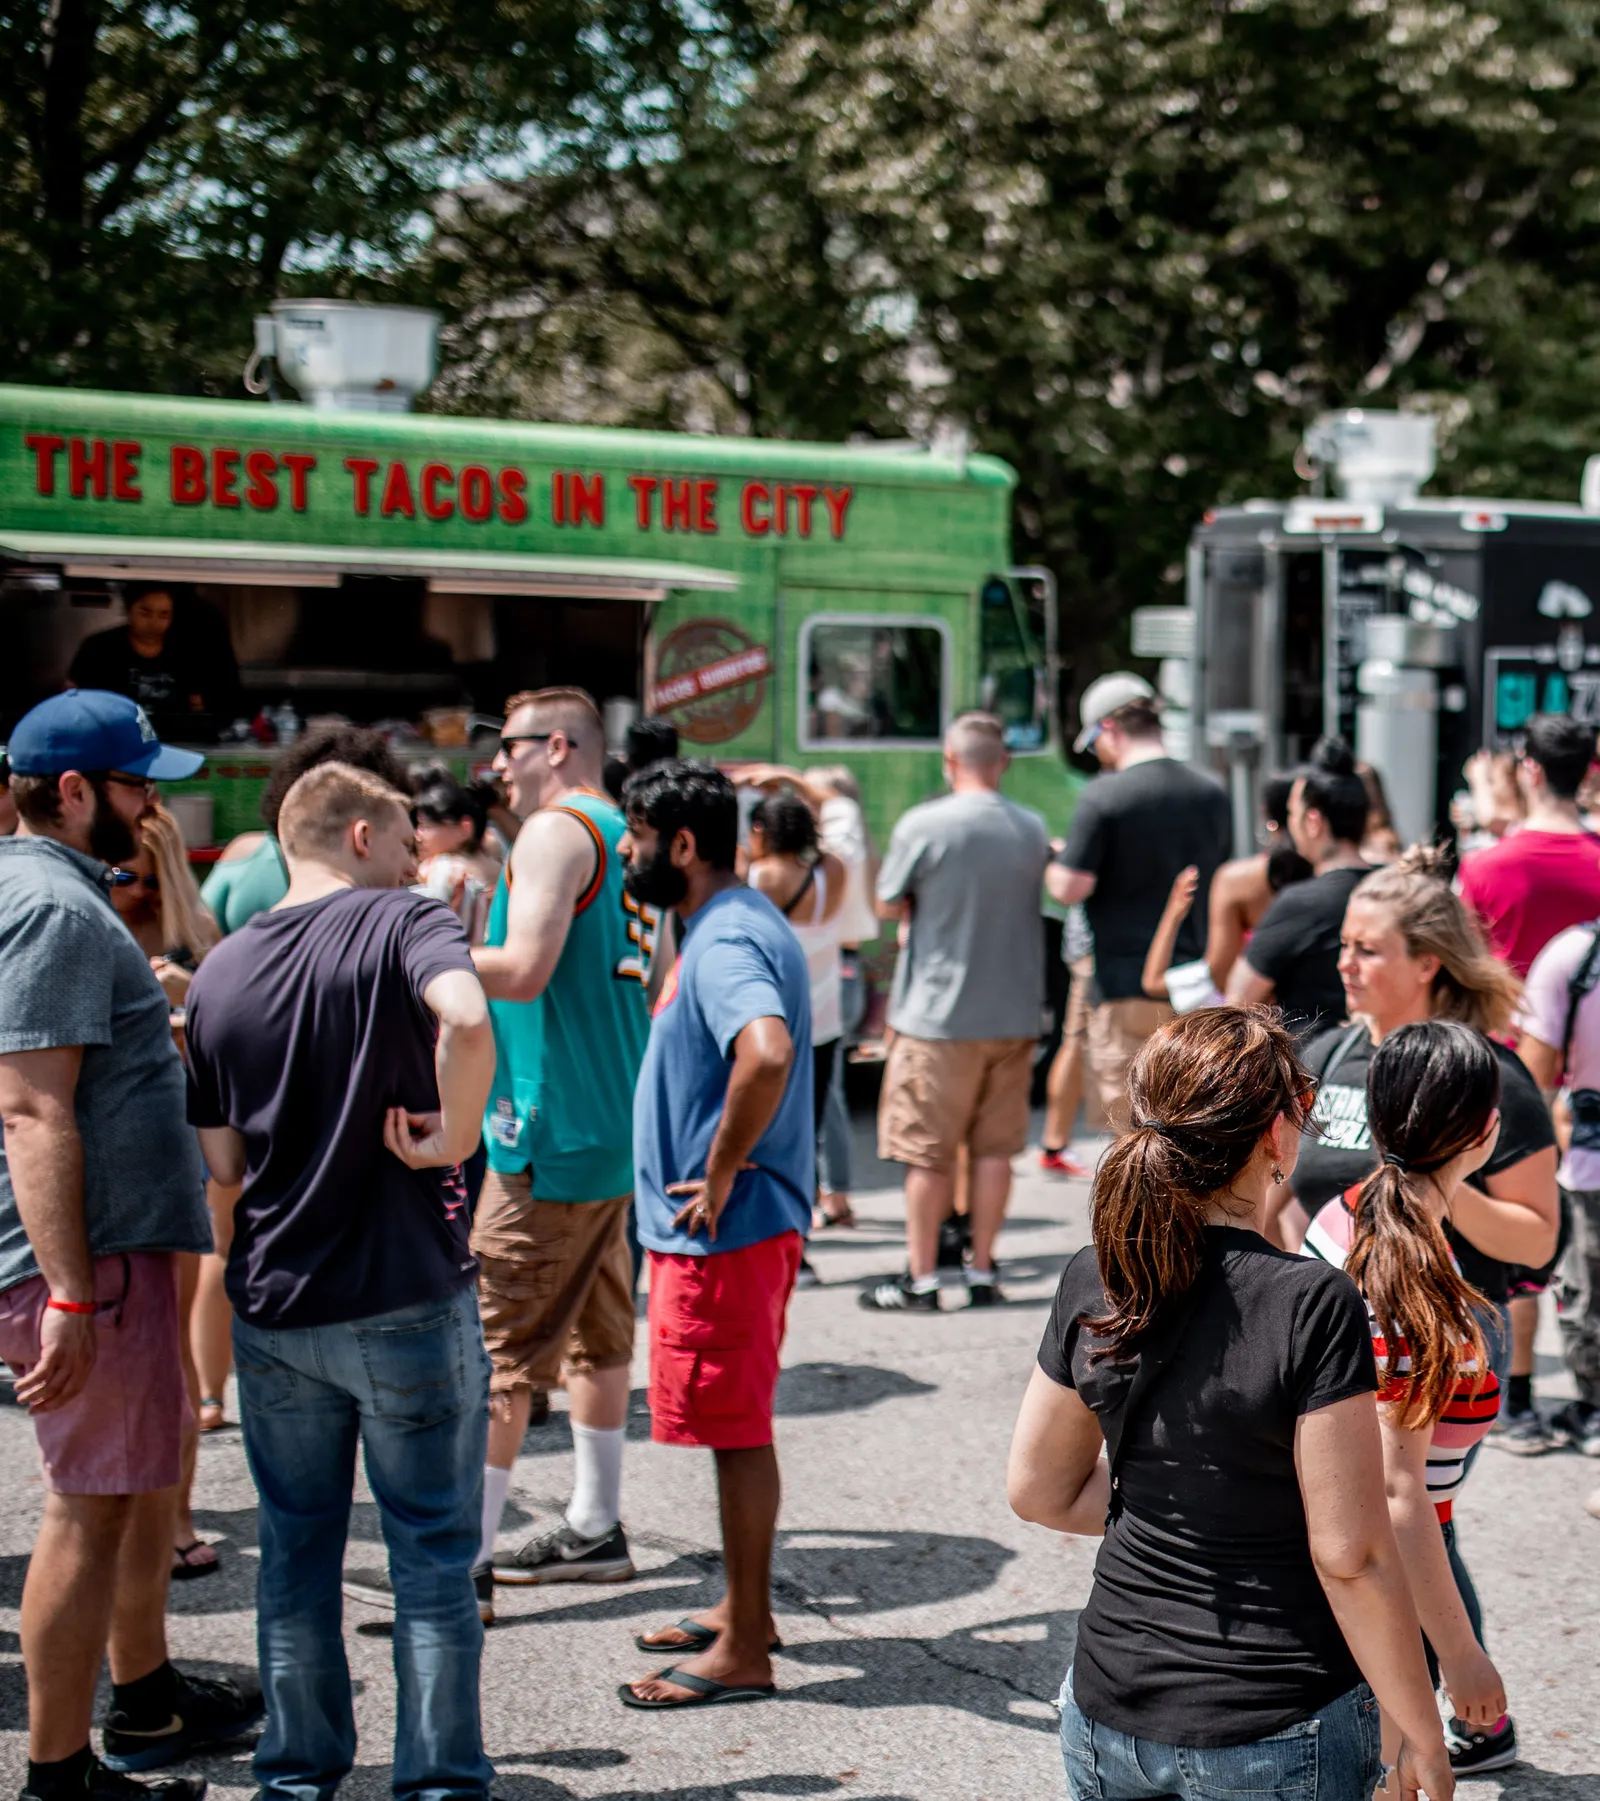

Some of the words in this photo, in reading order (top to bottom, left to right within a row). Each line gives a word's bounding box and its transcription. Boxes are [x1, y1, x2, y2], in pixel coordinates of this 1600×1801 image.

[25, 434, 142, 500] THE
[170, 444, 316, 511] BEST
[344, 457, 528, 524] TACOS
[552, 471, 604, 527] IN
[629, 475, 718, 534] THE
[740, 481, 852, 539] CITY
